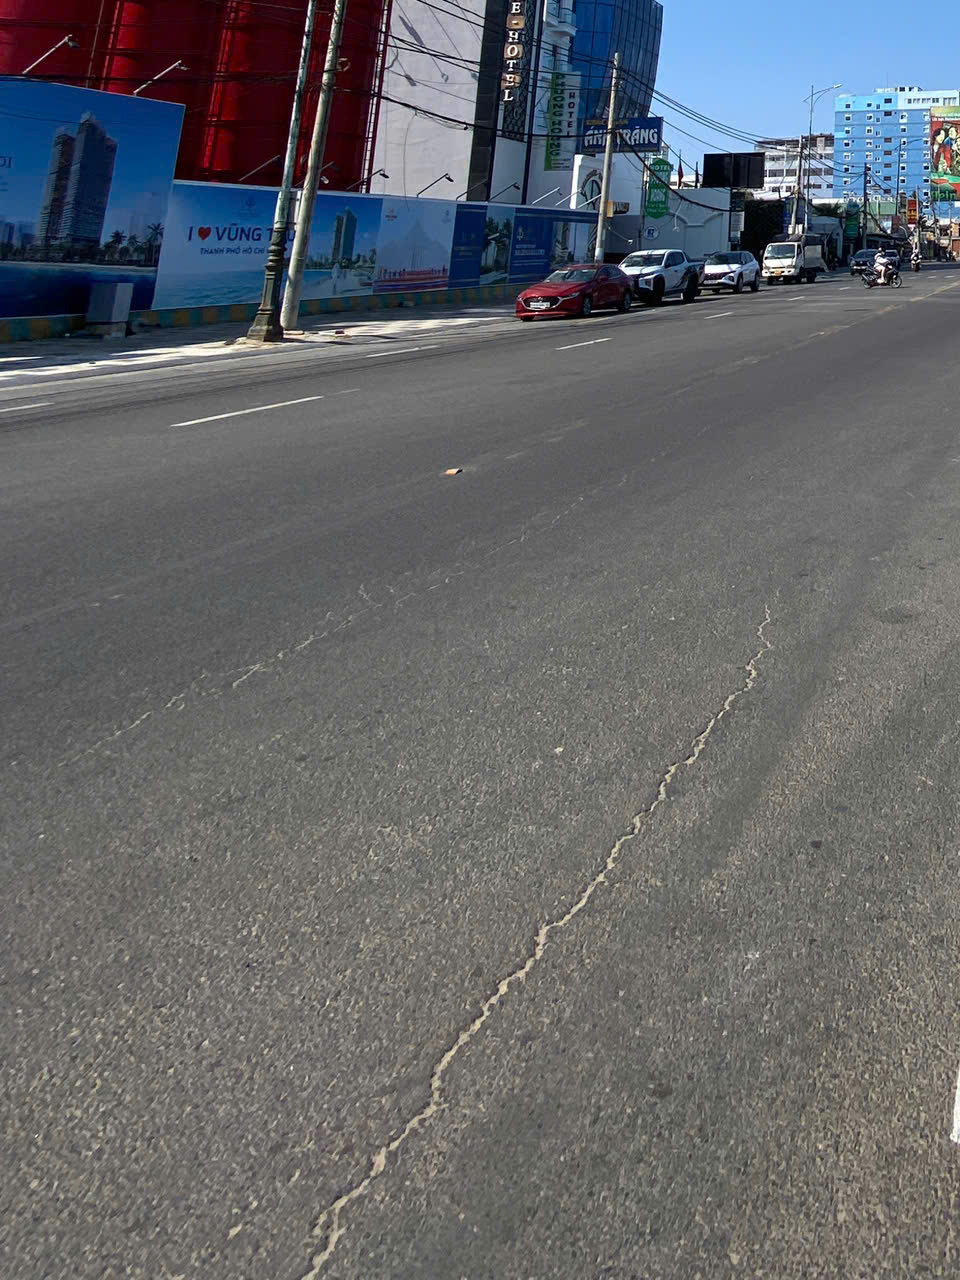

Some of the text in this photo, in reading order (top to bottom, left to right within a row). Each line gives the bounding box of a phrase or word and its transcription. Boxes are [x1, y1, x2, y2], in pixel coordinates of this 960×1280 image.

[503, 31, 520, 101] HOTEL
[566, 91, 576, 138] HOTEL
[188, 222, 297, 241] I VŨNG TU
